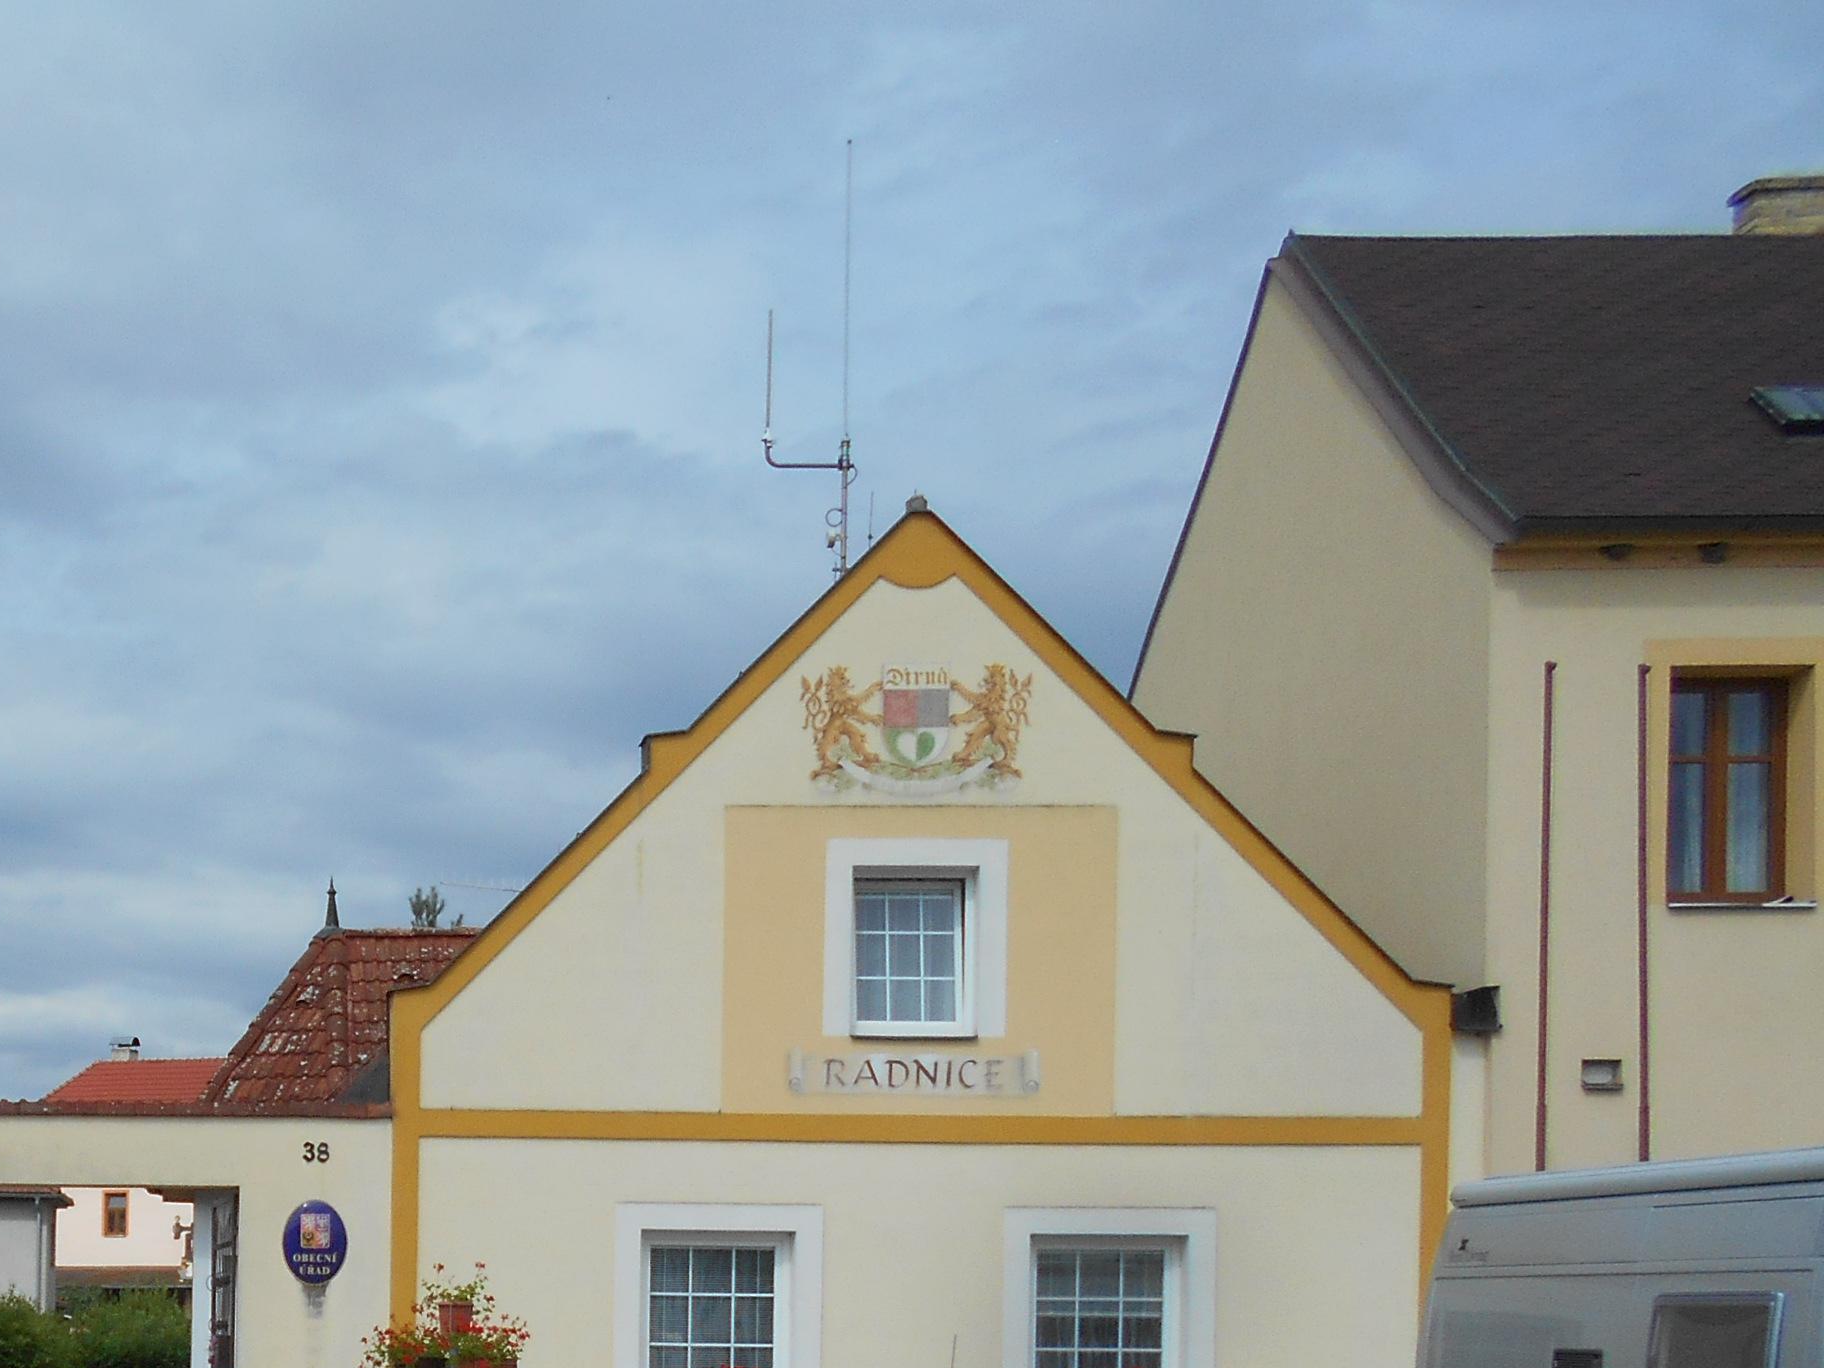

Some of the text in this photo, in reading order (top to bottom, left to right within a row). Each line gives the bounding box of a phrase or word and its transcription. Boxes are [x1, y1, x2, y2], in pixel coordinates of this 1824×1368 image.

[824, 1058, 1005, 1088] RADNICE
[303, 1142, 330, 1163] 38
[293, 1252, 338, 1263] OBECNÍ
